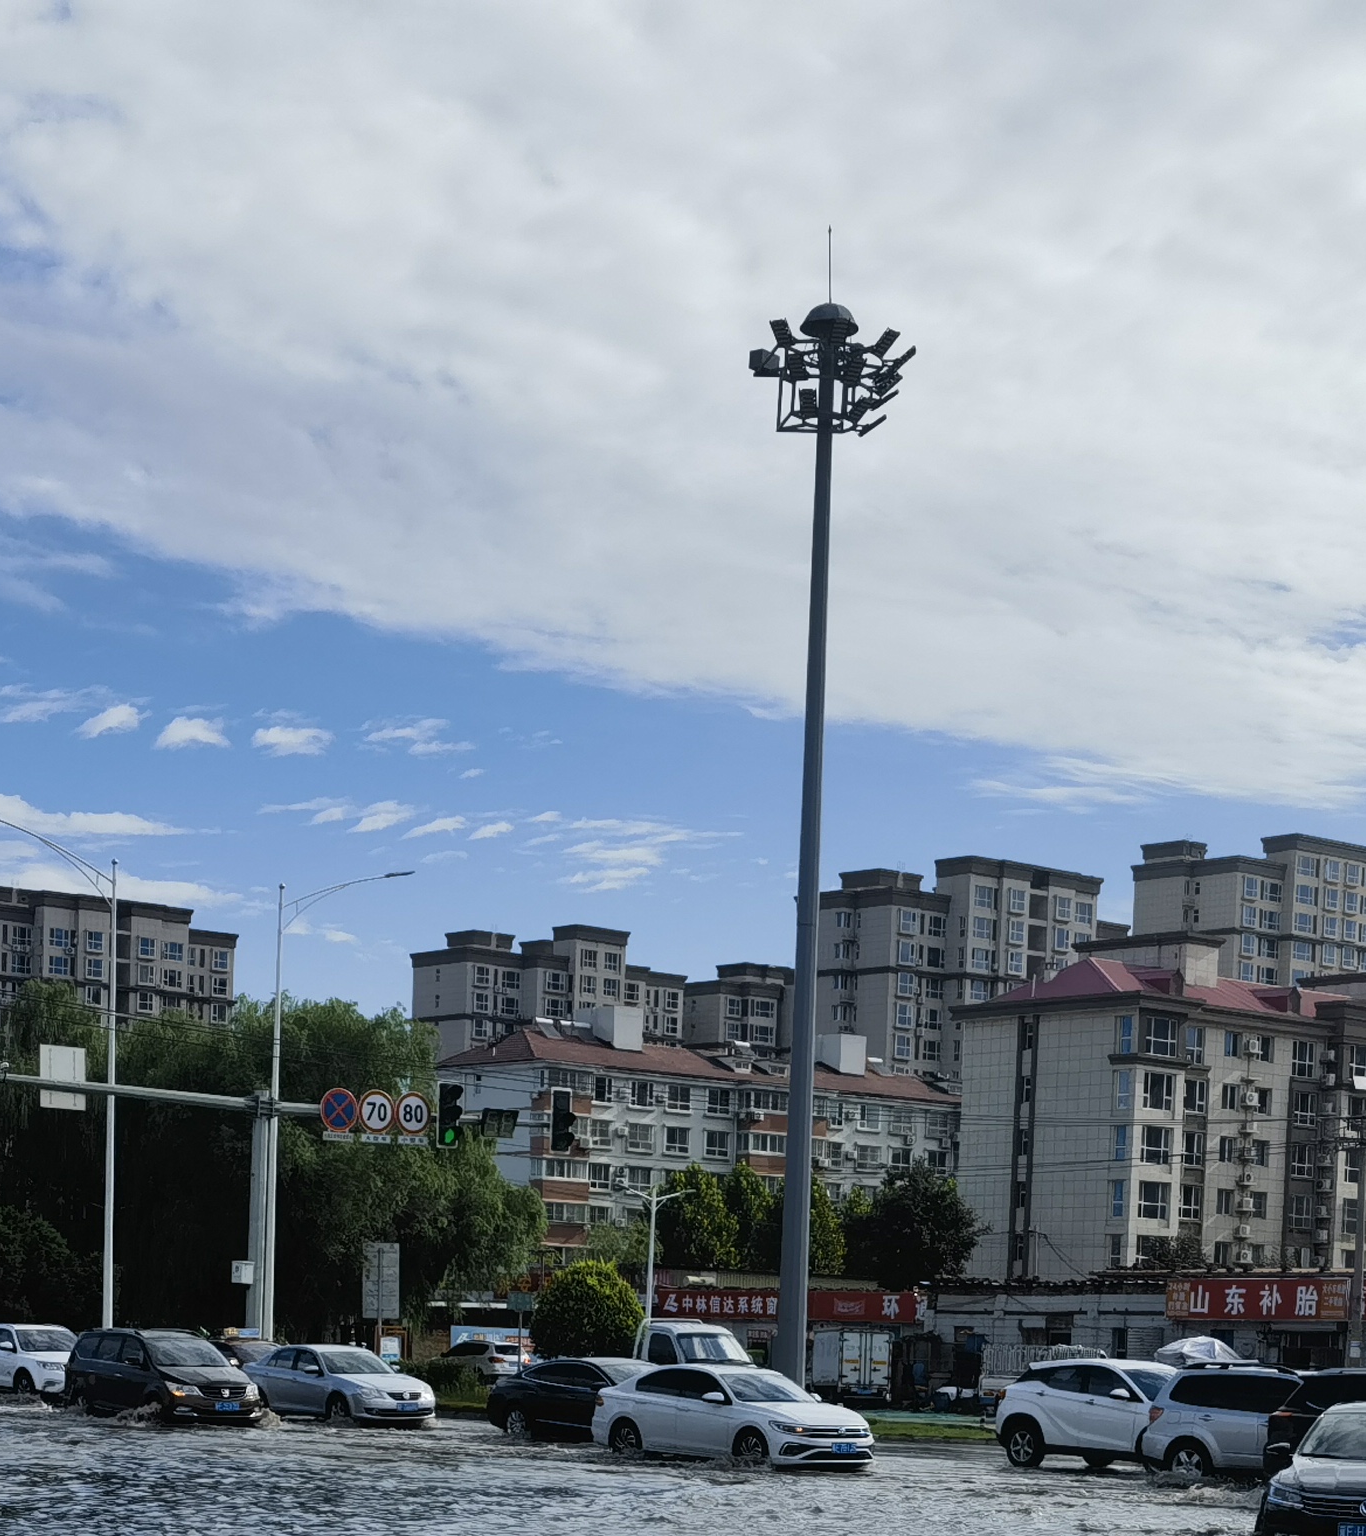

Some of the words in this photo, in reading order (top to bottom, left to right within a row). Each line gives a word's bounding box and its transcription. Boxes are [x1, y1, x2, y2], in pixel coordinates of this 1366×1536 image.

[366, 1101, 386, 1122] 70
[403, 1103, 423, 1123] 80
[682, 1296, 779, 1316] 中林信达系统窗
[1190, 1284, 1319, 1316] 山东补胎
